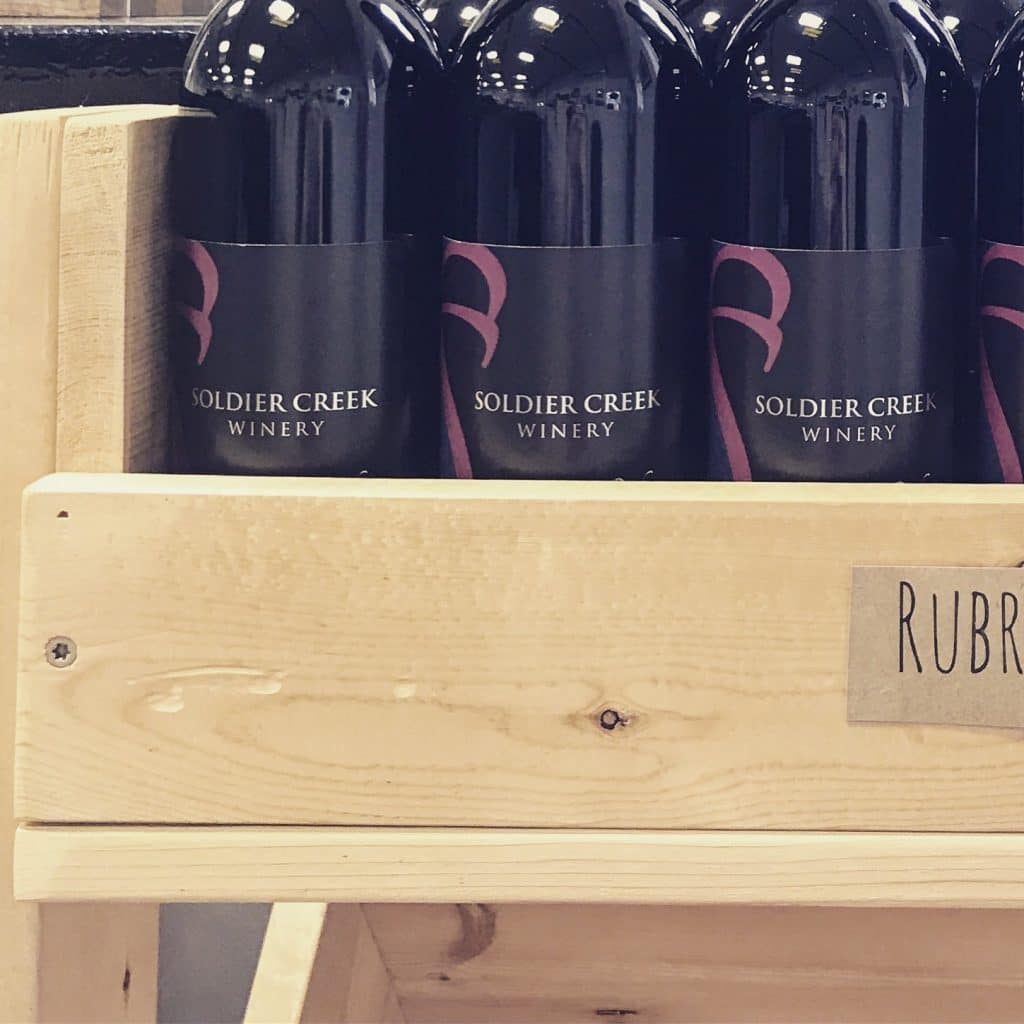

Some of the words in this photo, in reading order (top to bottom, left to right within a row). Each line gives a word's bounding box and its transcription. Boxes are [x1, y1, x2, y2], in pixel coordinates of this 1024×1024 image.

[192, 387, 288, 412] SOLDIER
[293, 388, 378, 412] CREEK
[474, 390, 578, 415] SOLDIER
[583, 389, 661, 414] CREEK
[755, 394, 863, 418] SOLDIER
[868, 392, 936, 418] CREEK
[228, 420, 325, 437] WINERY
[517, 422, 614, 439] WINERY
[801, 425, 896, 443] WINERY
